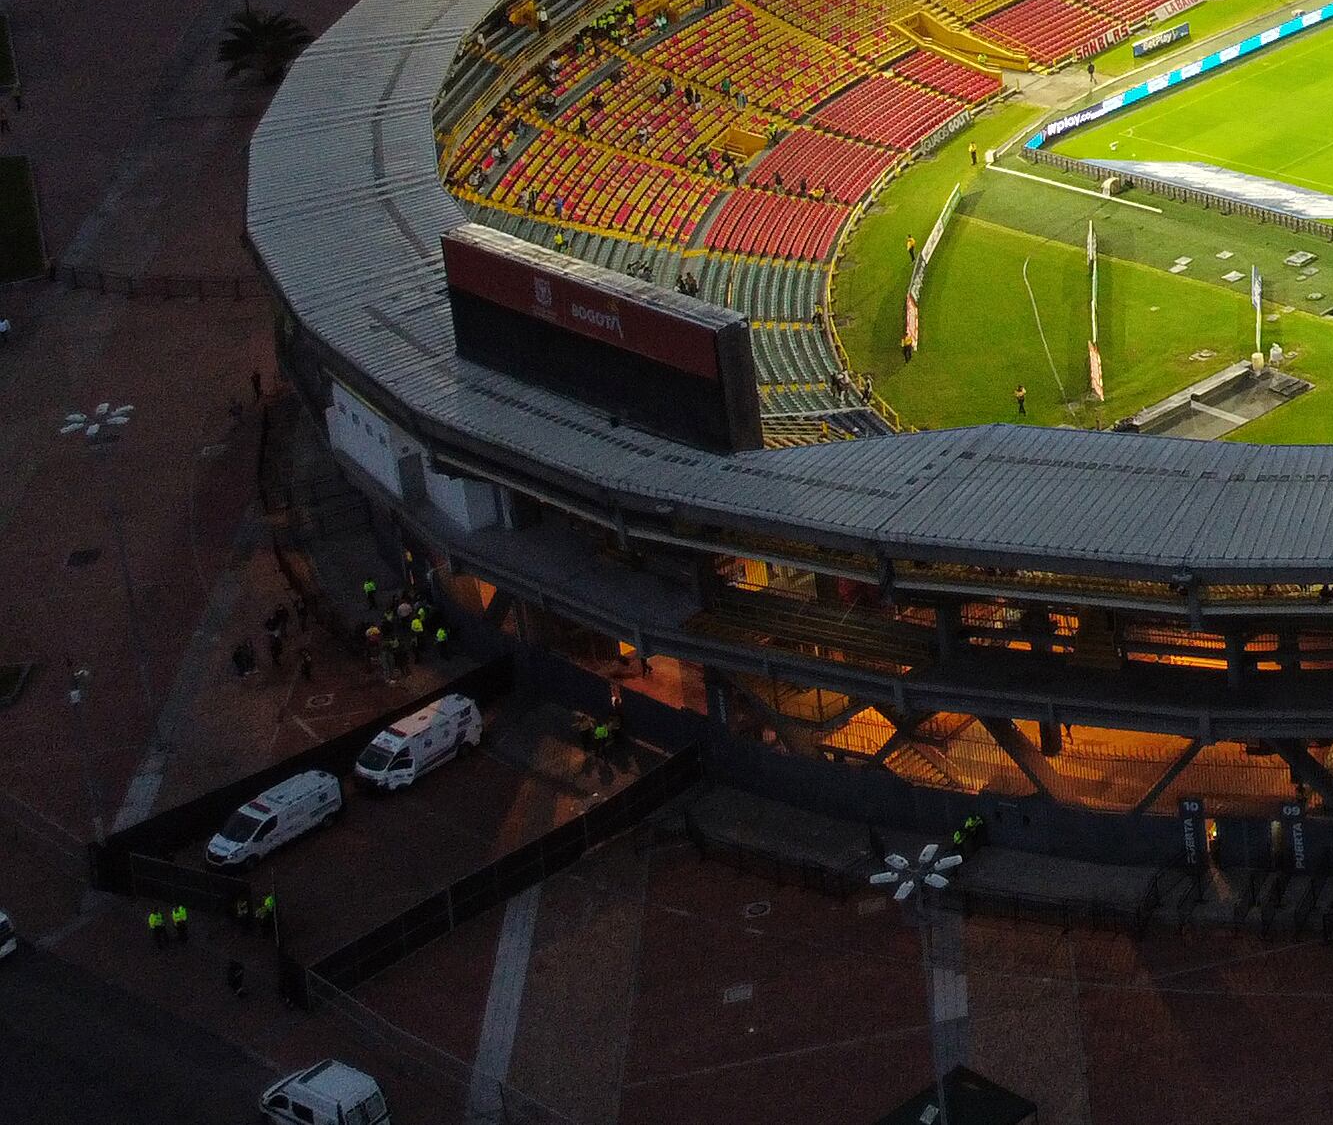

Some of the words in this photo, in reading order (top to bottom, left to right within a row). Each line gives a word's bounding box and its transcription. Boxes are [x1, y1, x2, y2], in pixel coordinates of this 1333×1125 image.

[949, 110, 972, 133] GOLTY
[1183, 801, 1199, 812] 10
[1283, 805, 1300, 816] 09
[1293, 822, 1305, 869] PUERTA
